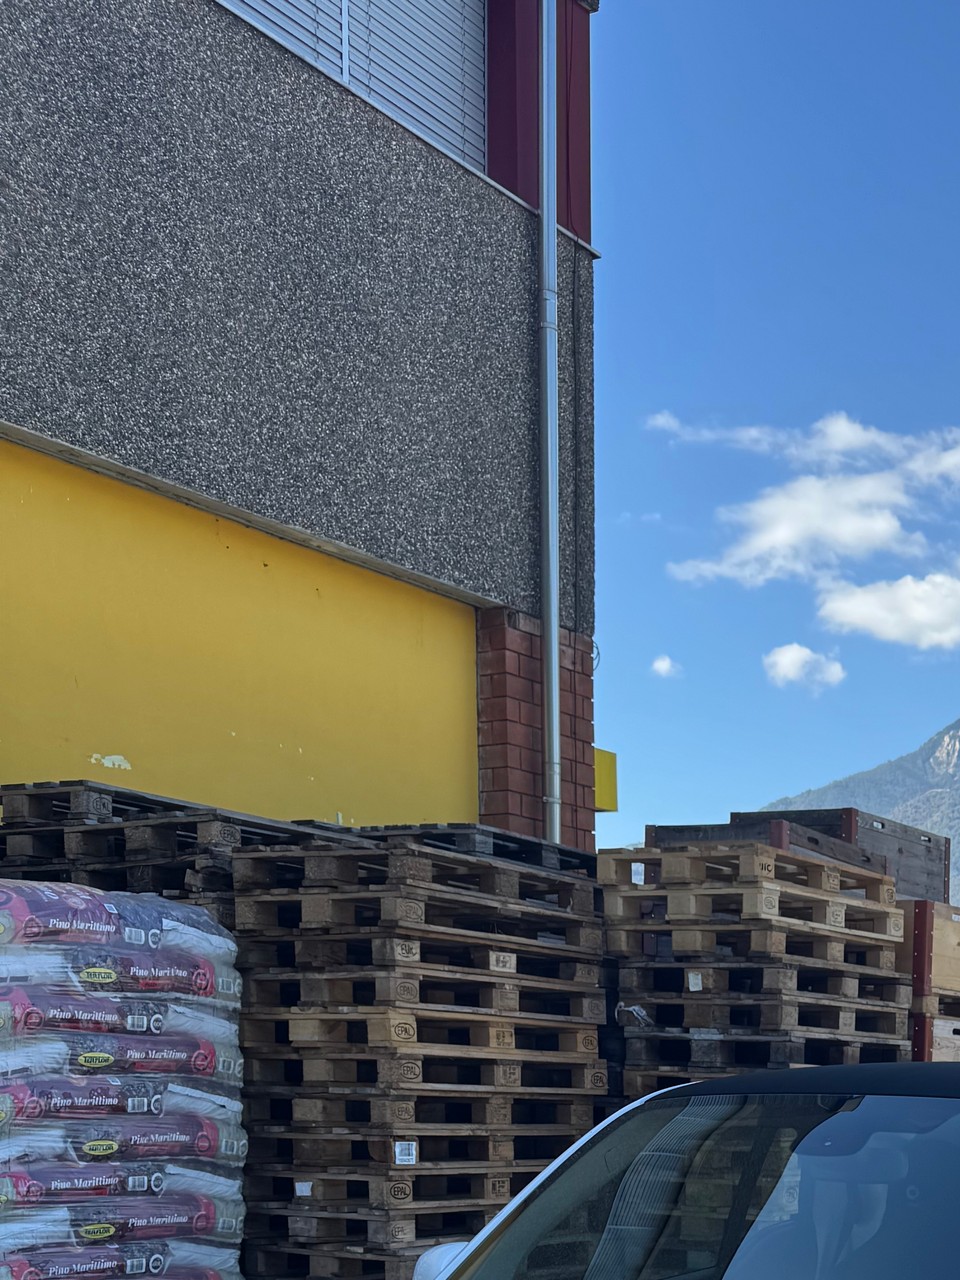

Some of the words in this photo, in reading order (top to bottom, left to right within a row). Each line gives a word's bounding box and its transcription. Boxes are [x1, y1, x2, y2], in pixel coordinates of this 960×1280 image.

[49, 918, 71, 929] Pino
[130, 966, 149, 977] Pino
[49, 1008, 71, 1019] Pino
[74, 1010, 118, 1021] Marittimo
[126, 1049, 146, 1059] Pino
[50, 1097, 72, 1107] Pino
[74, 1095, 119, 1106] Marittimo
[51, 1180, 71, 1190] Pino
[74, 1175, 119, 1188] Marittimo
[128, 1217, 148, 1228] Pino
[48, 1265, 70, 1276] Pino
[72, 1259, 118, 1273] Marittimo
